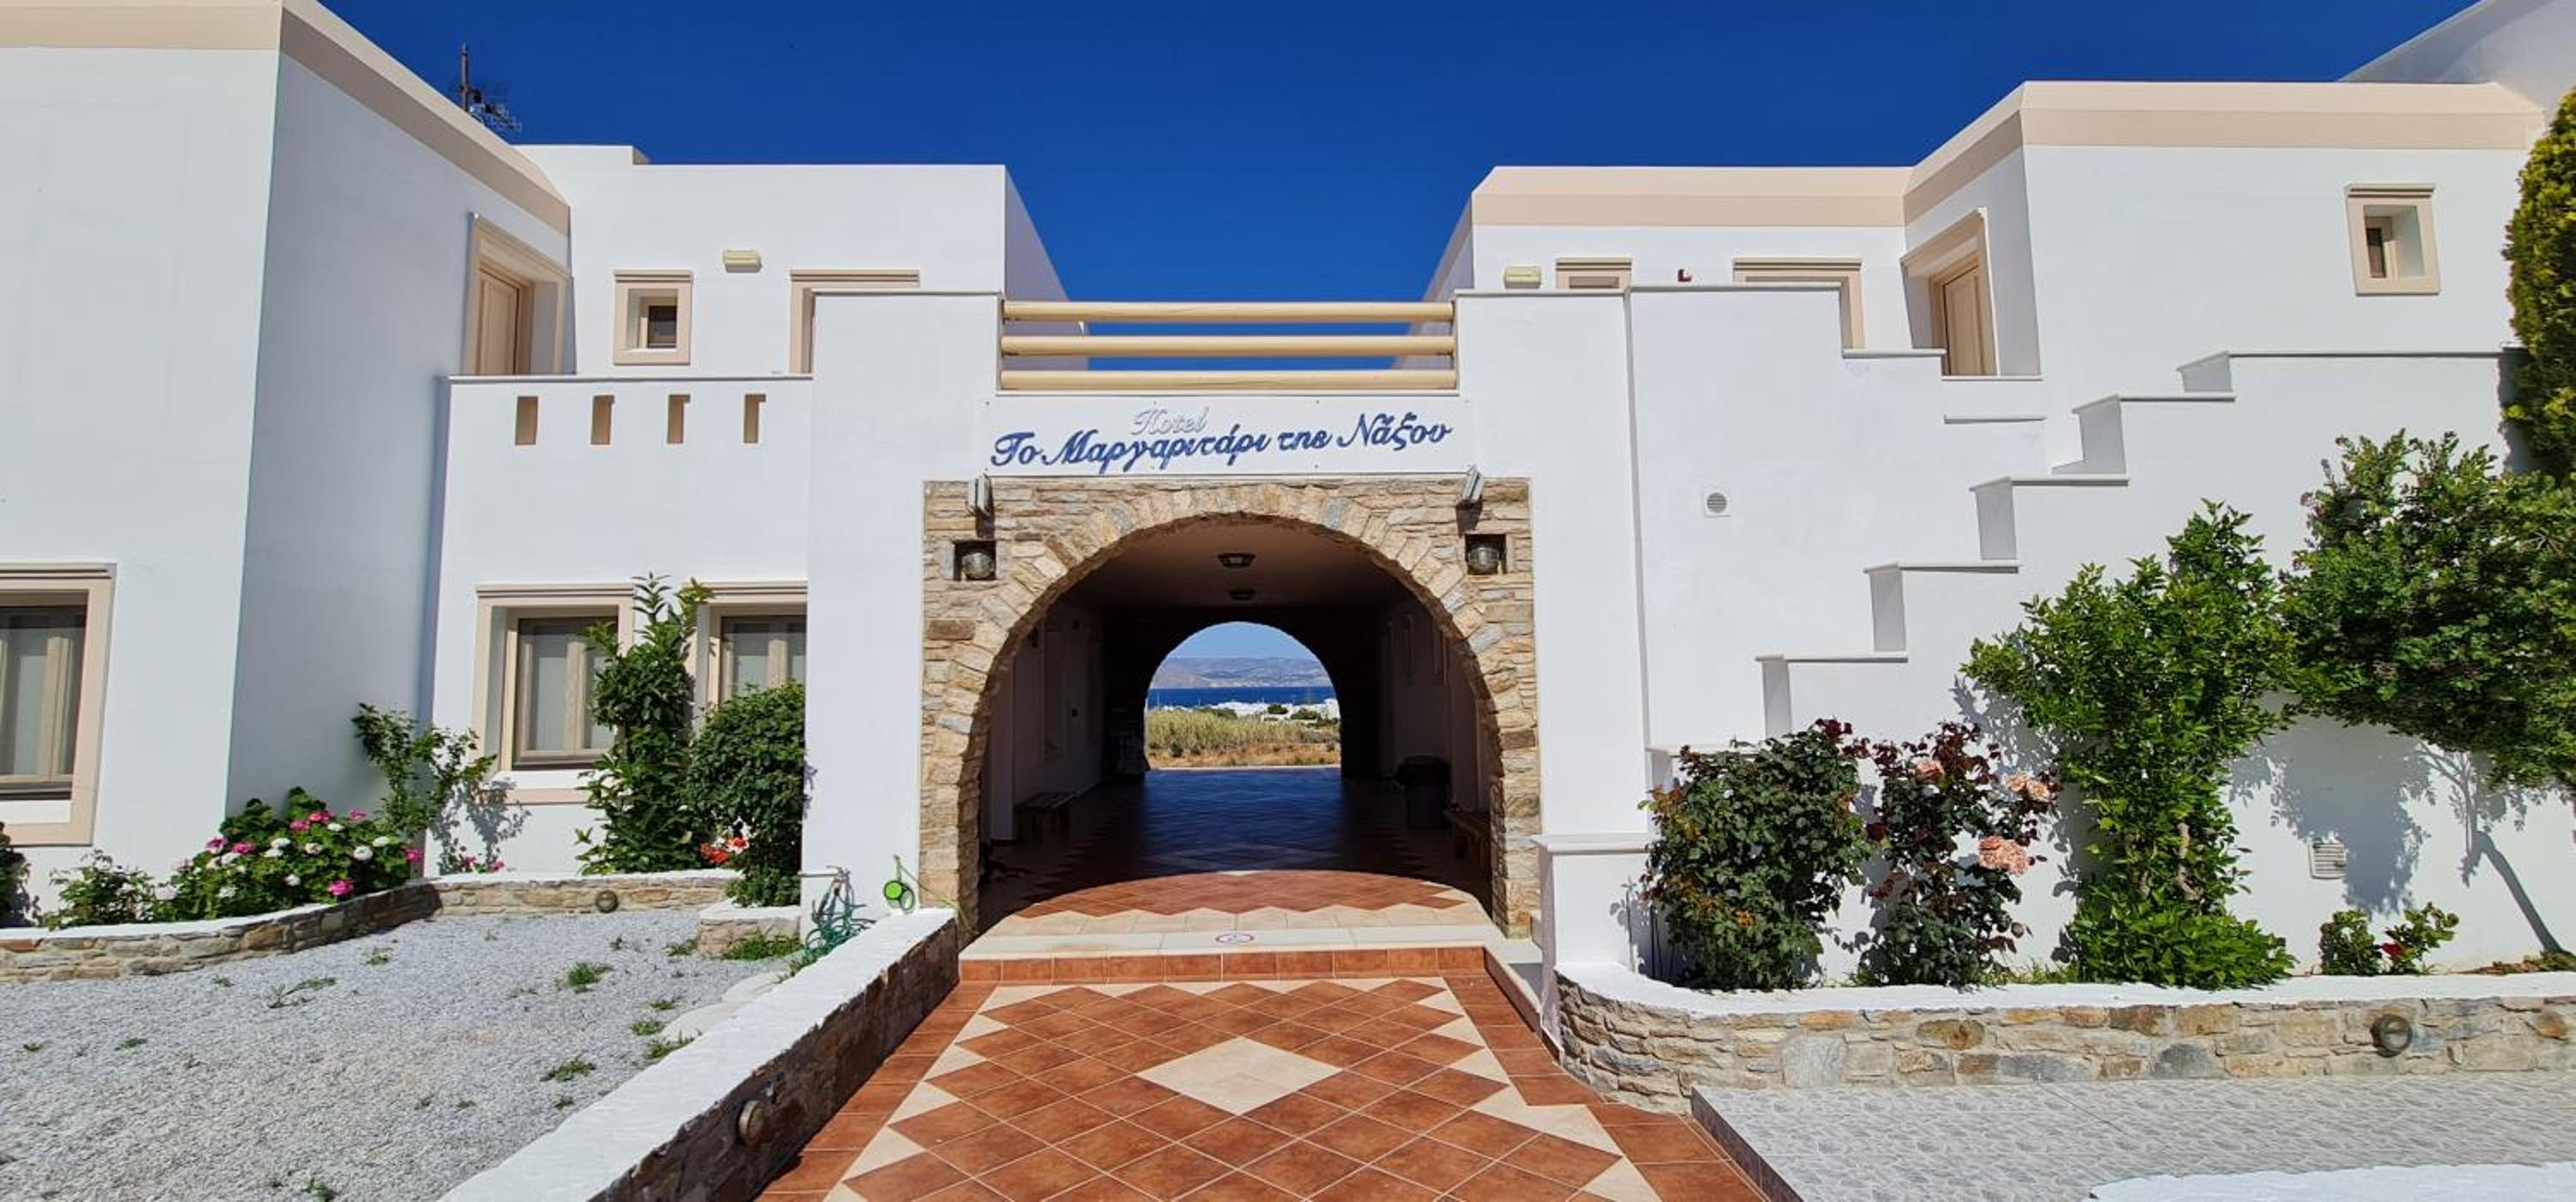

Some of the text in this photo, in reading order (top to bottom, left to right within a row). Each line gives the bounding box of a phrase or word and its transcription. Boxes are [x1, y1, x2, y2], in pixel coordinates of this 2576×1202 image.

[990, 432, 1043, 466] Το
[1041, 423, 1273, 474] Μαργαριτάρι
[1336, 411, 1453, 451] Νάξου
[1131, 407, 1209, 435] Hotel
